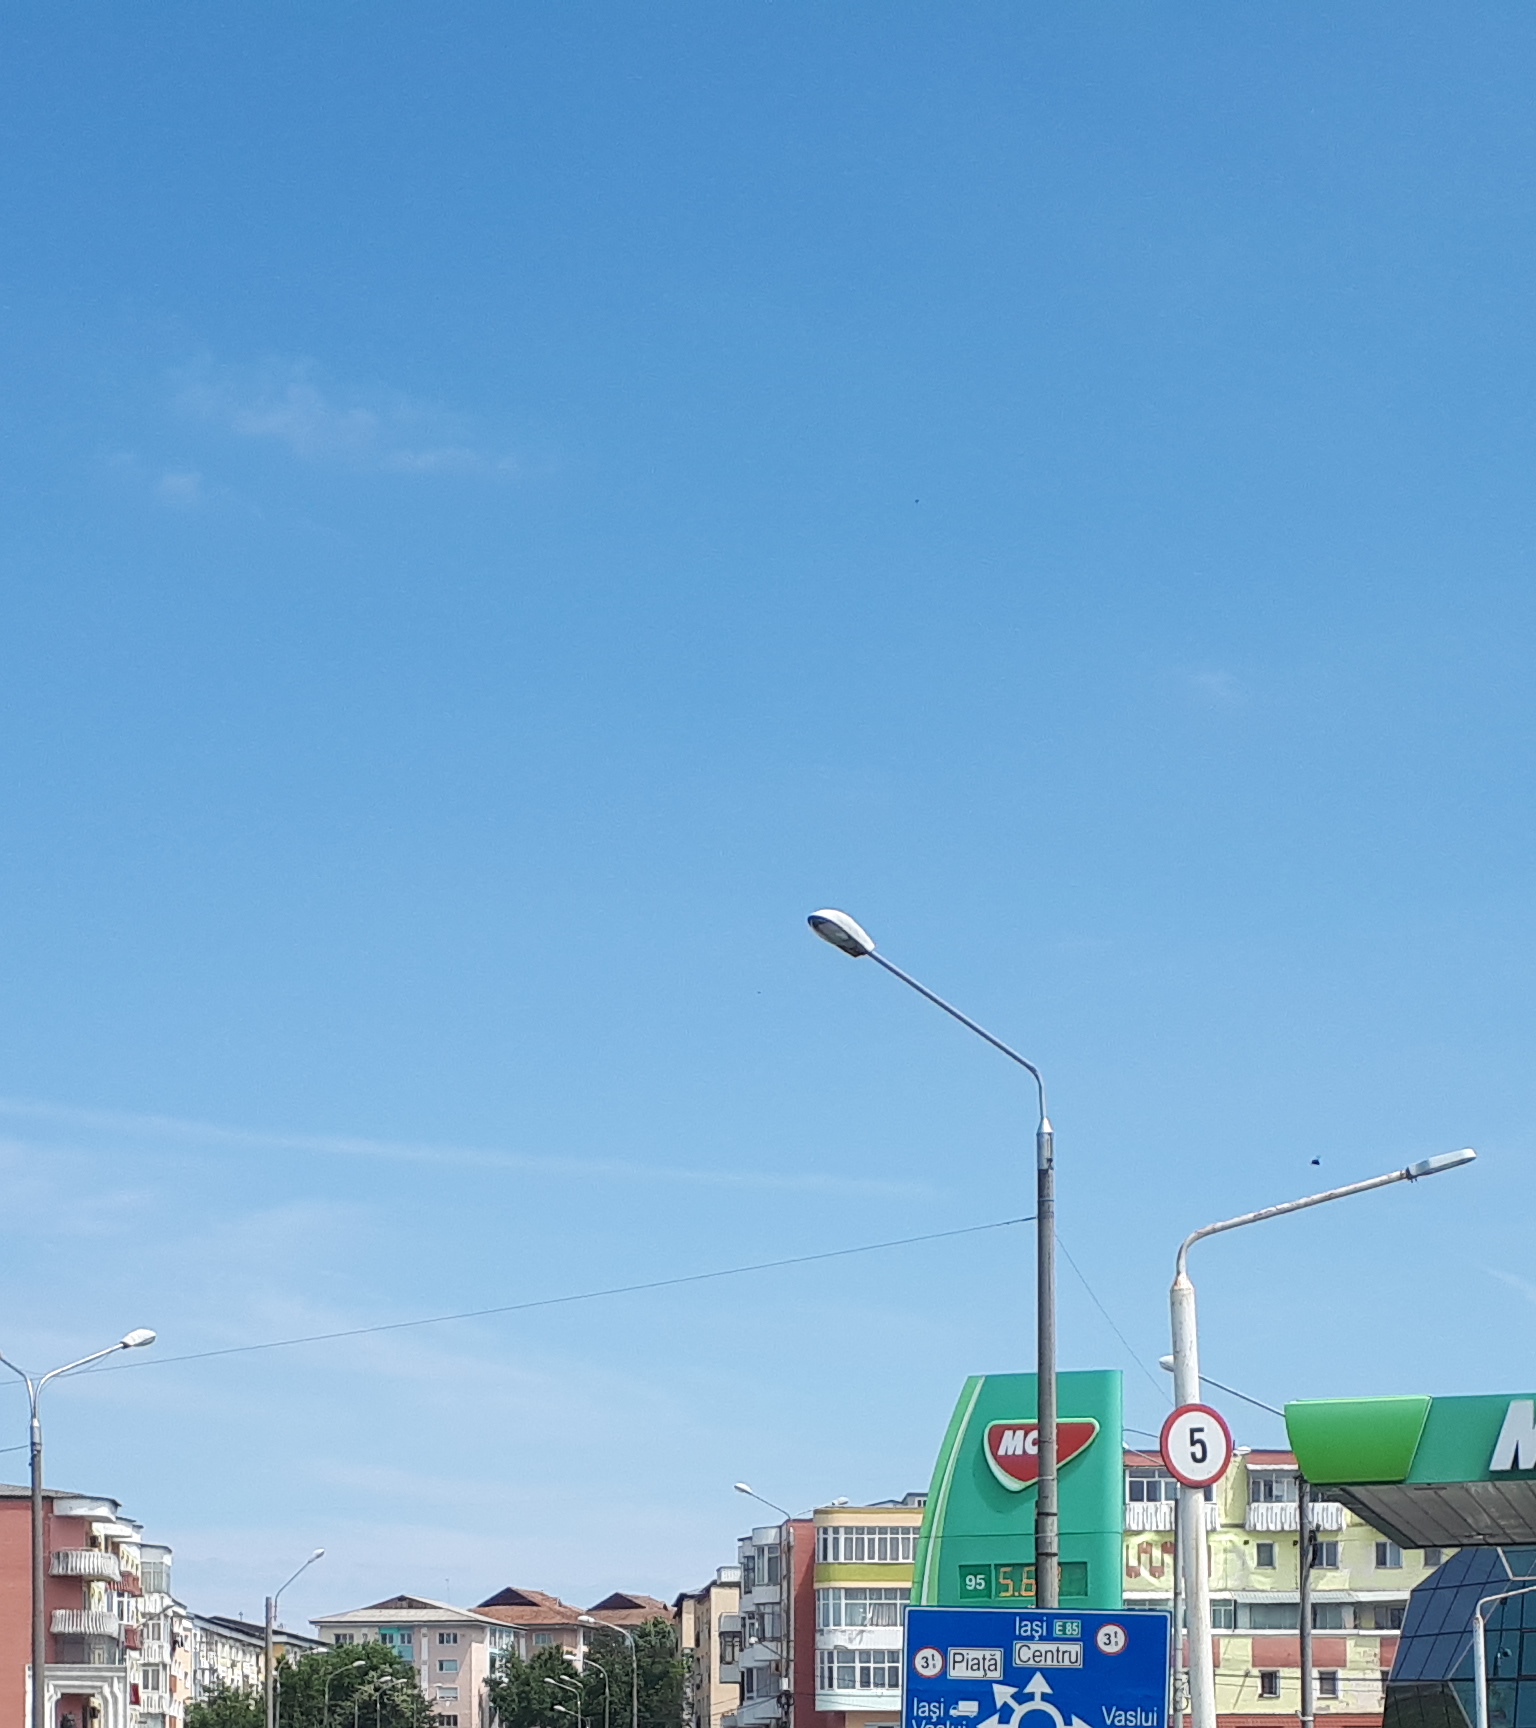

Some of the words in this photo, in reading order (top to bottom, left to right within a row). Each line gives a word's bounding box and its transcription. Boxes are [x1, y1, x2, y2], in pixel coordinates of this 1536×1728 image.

[998, 1430, 1058, 1456] MO
[1189, 1427, 1208, 1464] 5
[965, 1575, 985, 1590] 95
[1055, 1621, 1063, 1635] E
[1065, 1622, 1079, 1636] 85
[1017, 1644, 1079, 1664] Centru
[1102, 1706, 1157, 1726] Vaslui
